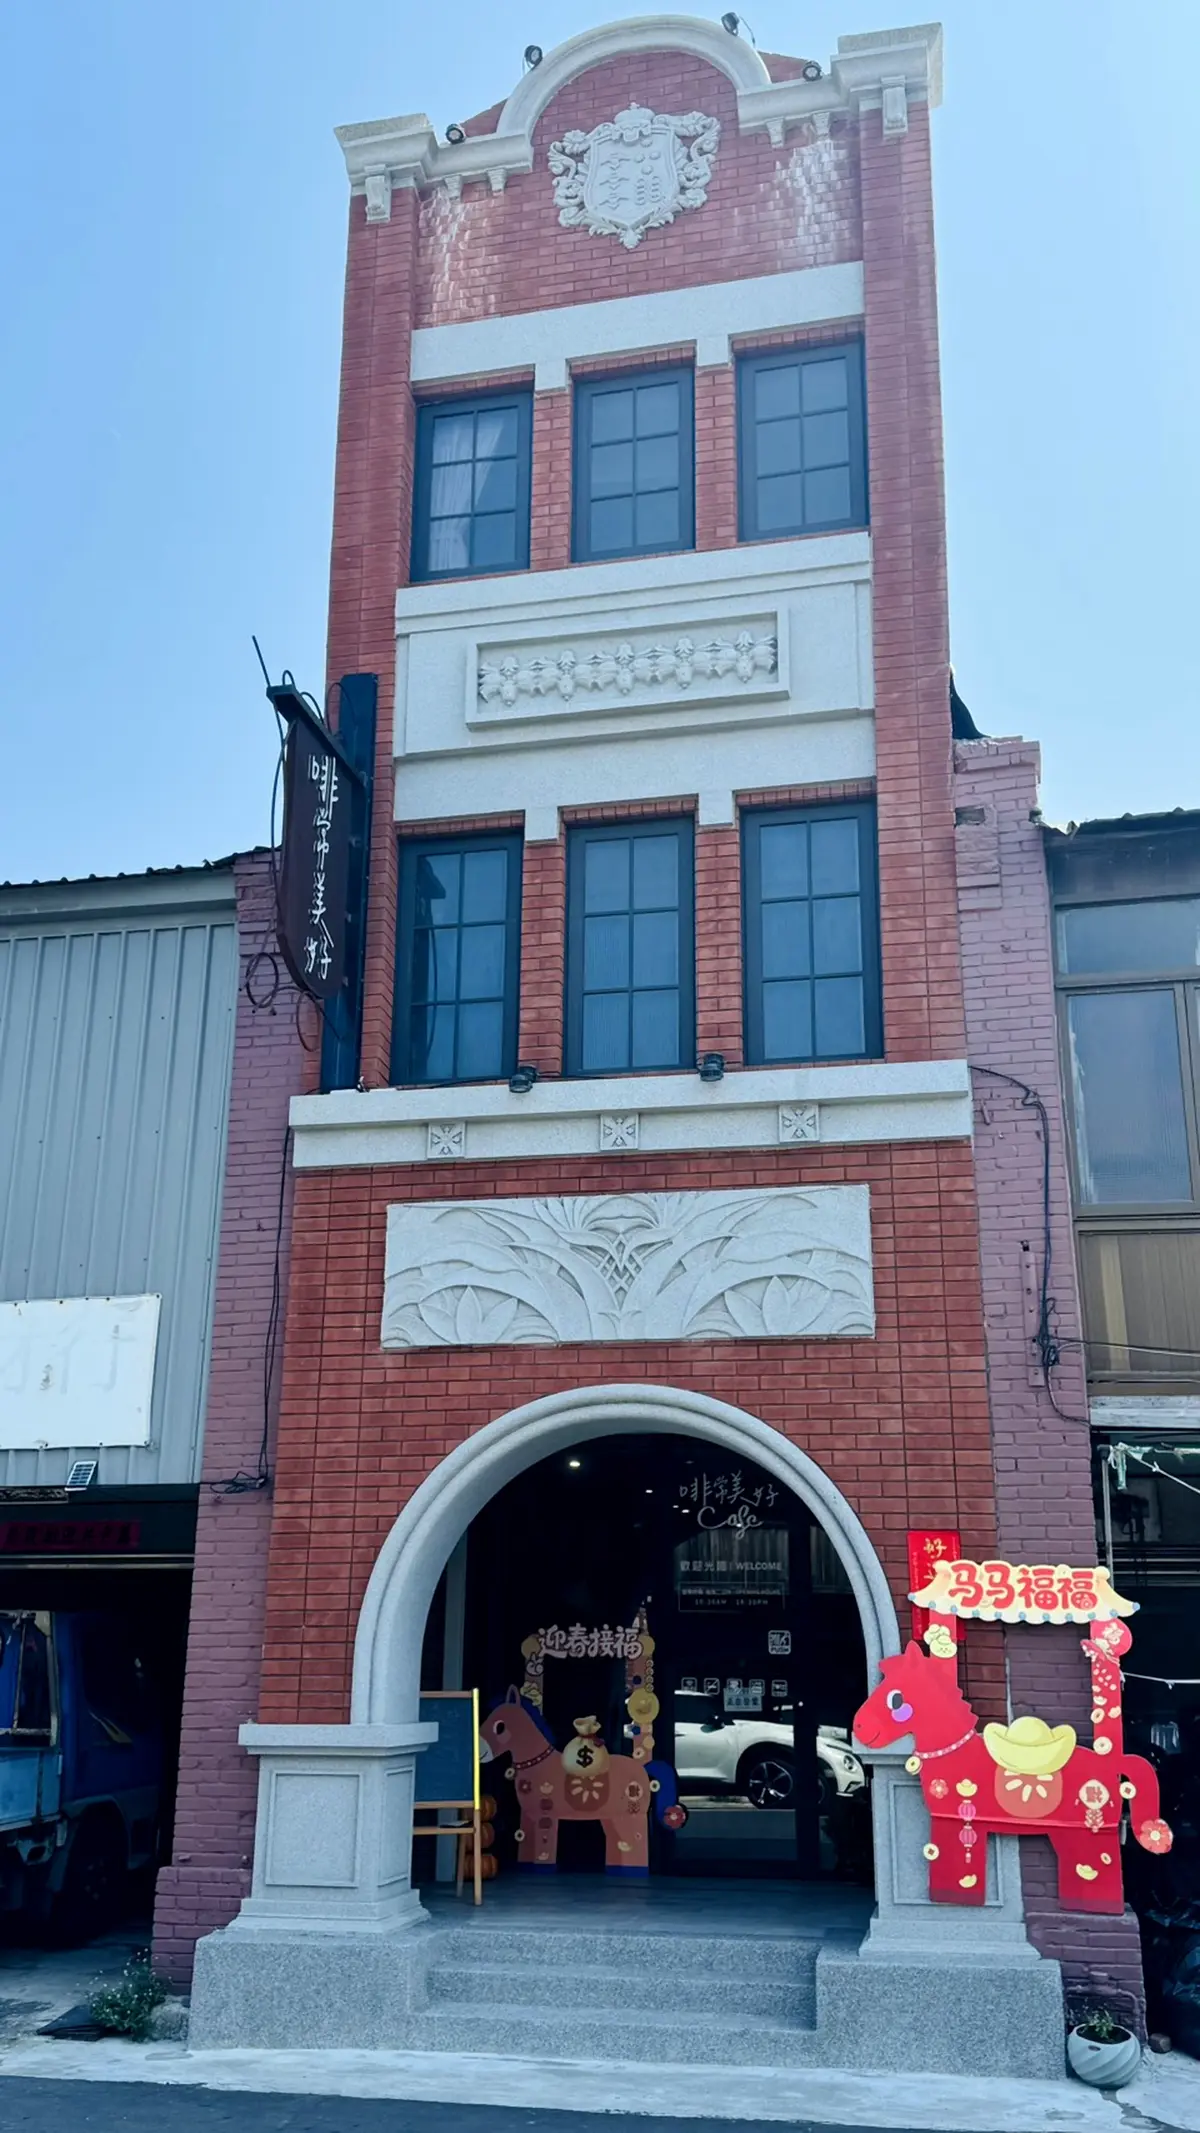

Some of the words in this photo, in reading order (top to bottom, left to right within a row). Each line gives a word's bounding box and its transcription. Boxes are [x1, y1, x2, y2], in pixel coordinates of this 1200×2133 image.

[735, 1561, 783, 1571] WELCOME
[538, 1622, 643, 1660] 迎春接福
